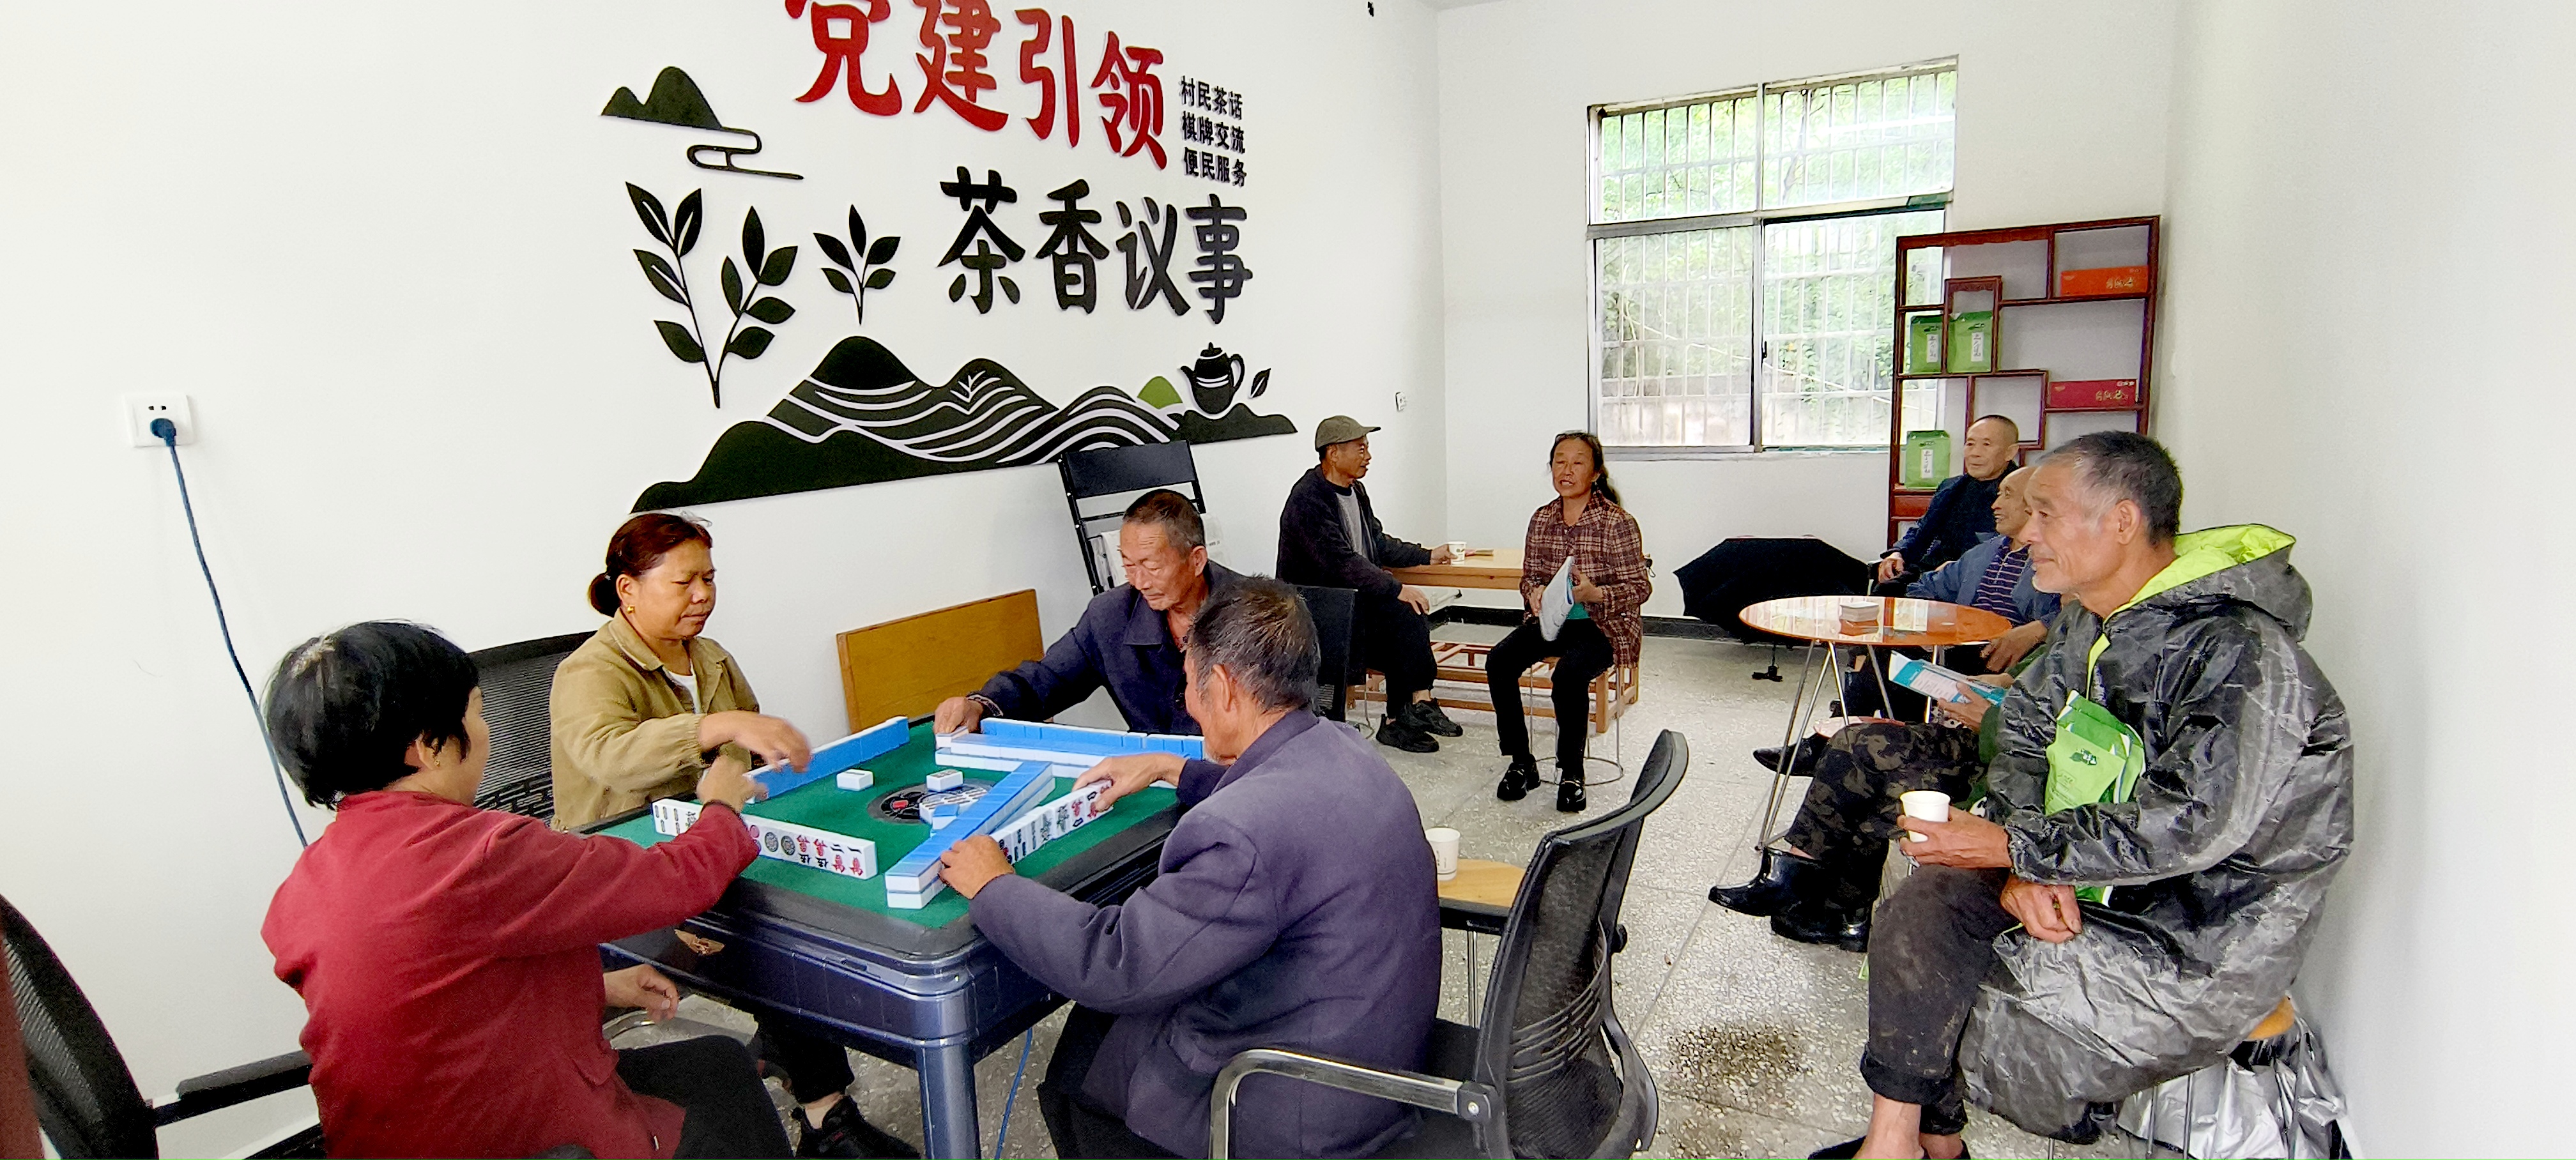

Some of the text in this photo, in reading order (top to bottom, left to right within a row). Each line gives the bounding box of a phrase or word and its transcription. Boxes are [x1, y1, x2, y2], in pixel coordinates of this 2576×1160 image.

[785, 0, 1167, 169] 党建引领
[1179, 75, 1243, 120] 村民茶话
[1181, 111, 1245, 154] 棋牌交流
[1183, 146, 1246, 187] 便民服务
[937, 166, 1253, 324] 茶香议事
